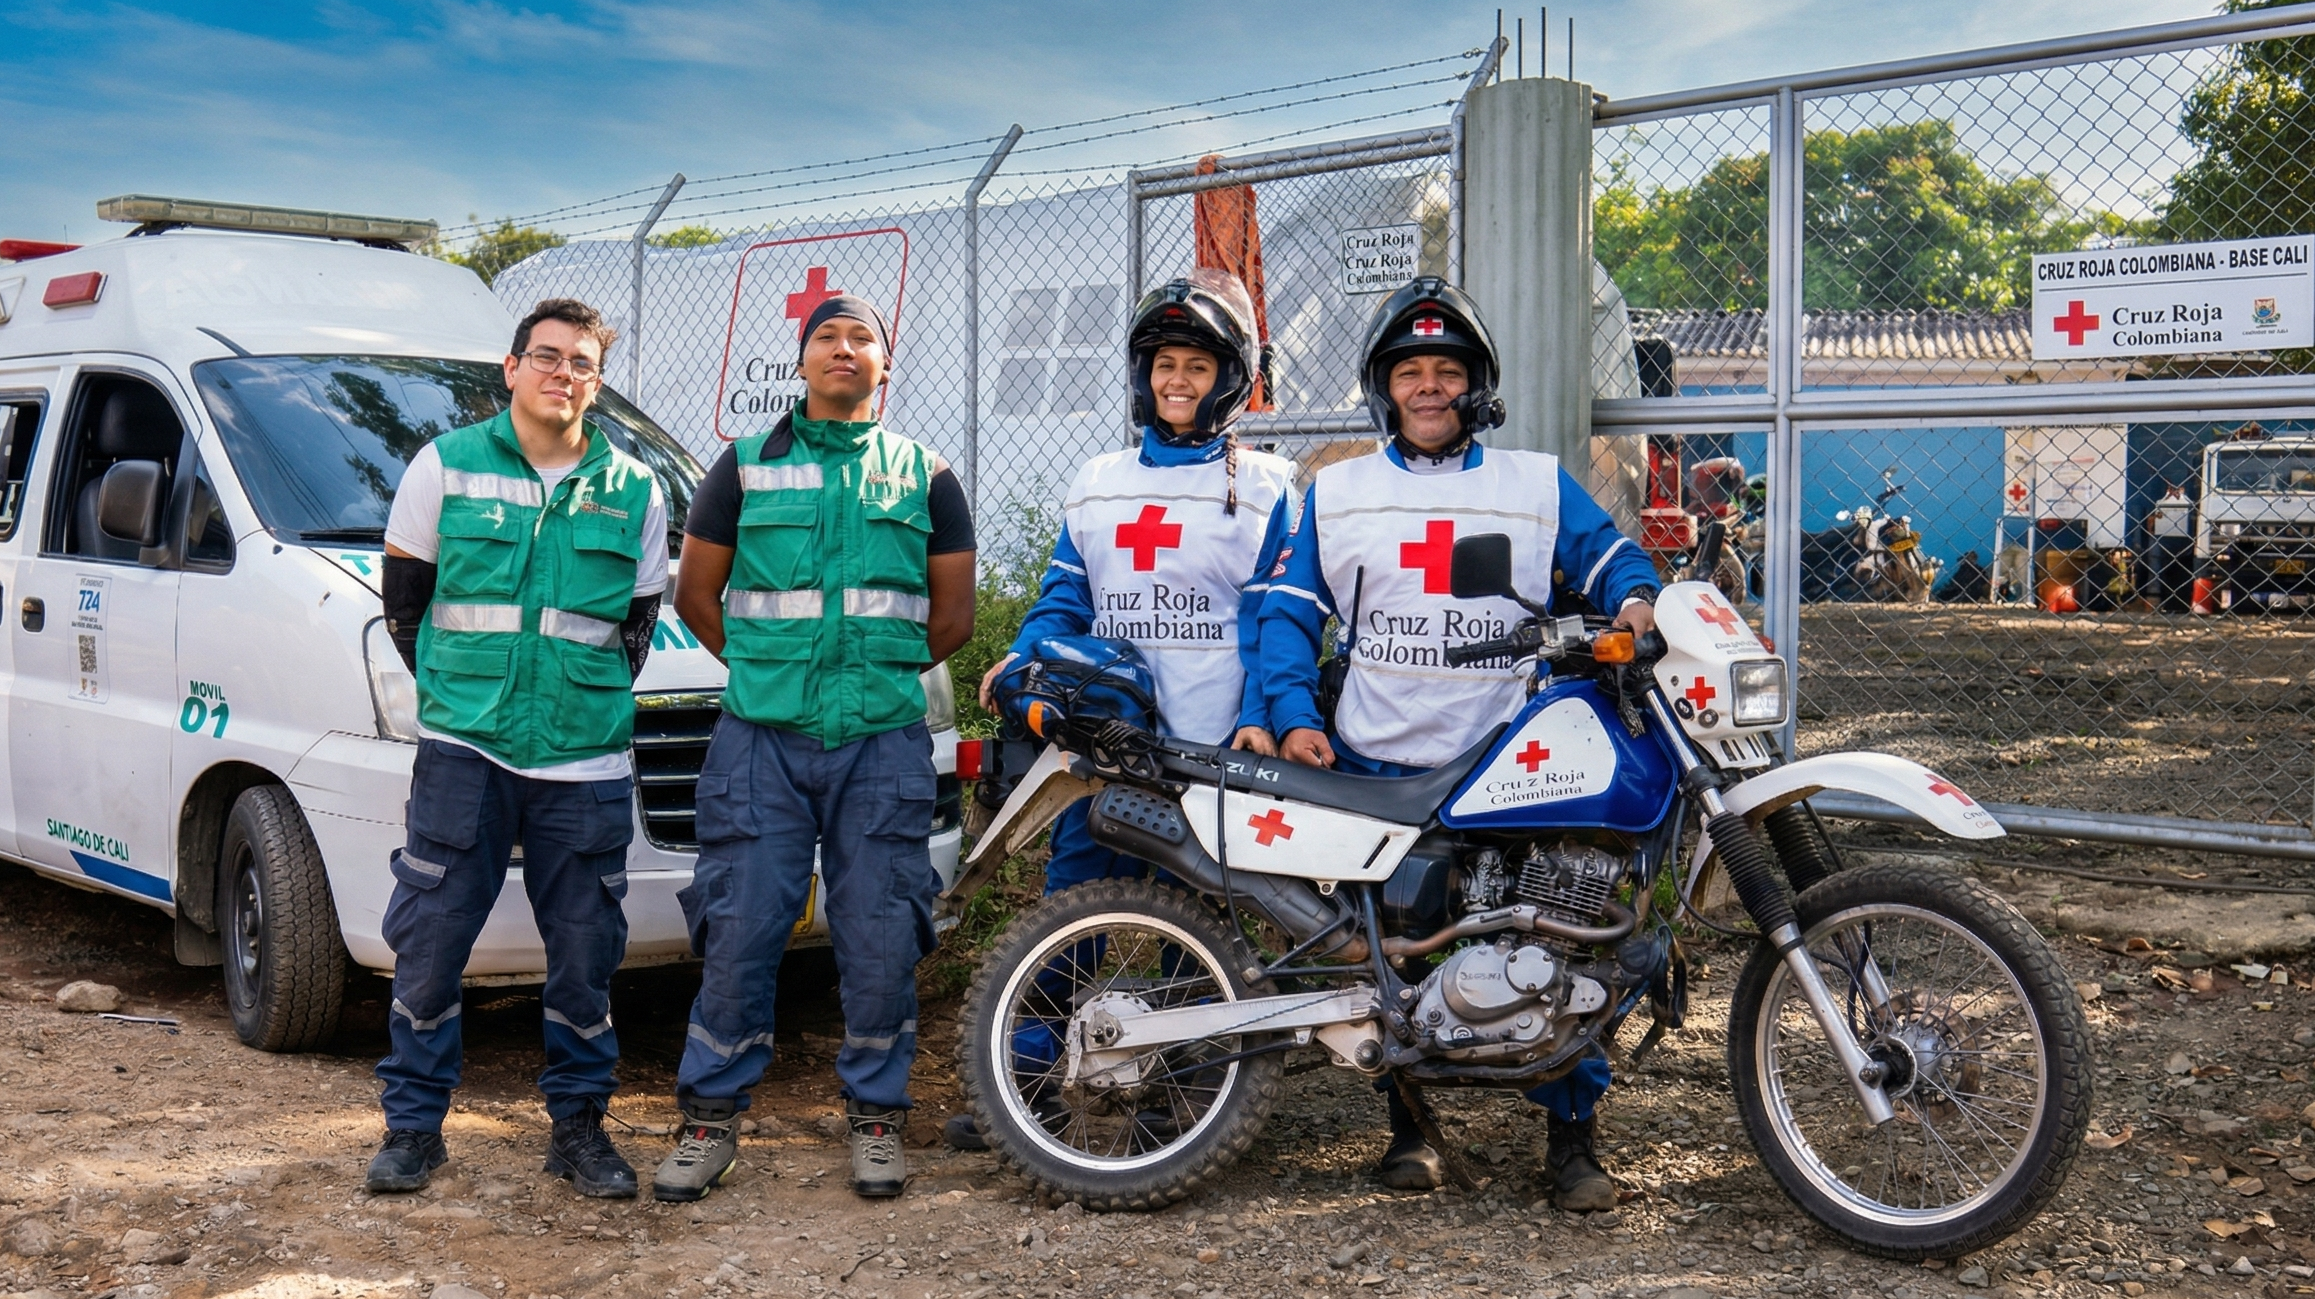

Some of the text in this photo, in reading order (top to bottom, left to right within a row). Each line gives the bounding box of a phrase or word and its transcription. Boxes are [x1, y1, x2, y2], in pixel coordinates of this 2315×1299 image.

[1380, 253, 1412, 269] Roja
[2038, 262, 2075, 281] CRUZ
[2079, 258, 2116, 278] ROJA
[2119, 251, 2216, 275] COLOMBIANA
[2229, 248, 2269, 269] BASE
[2273, 244, 2308, 266] CALI
[2112, 302, 2223, 326] Cruz Roja
[2112, 327, 2223, 347] Colombiana
[745, 357, 799, 383] Cruz
[78, 589, 101, 613] 724
[1100, 583, 1211, 618] ruz Roja
[1096, 613, 1225, 640] olombiana
[1369, 609, 1506, 643] Cruz Roja
[180, 696, 230, 739] 01
[1212, 760, 1280, 782] ZUKI
[1545, 769, 1585, 784] Roja
[47, 818, 92, 850] SANTIAGO
[93, 832, 106, 855] DE
